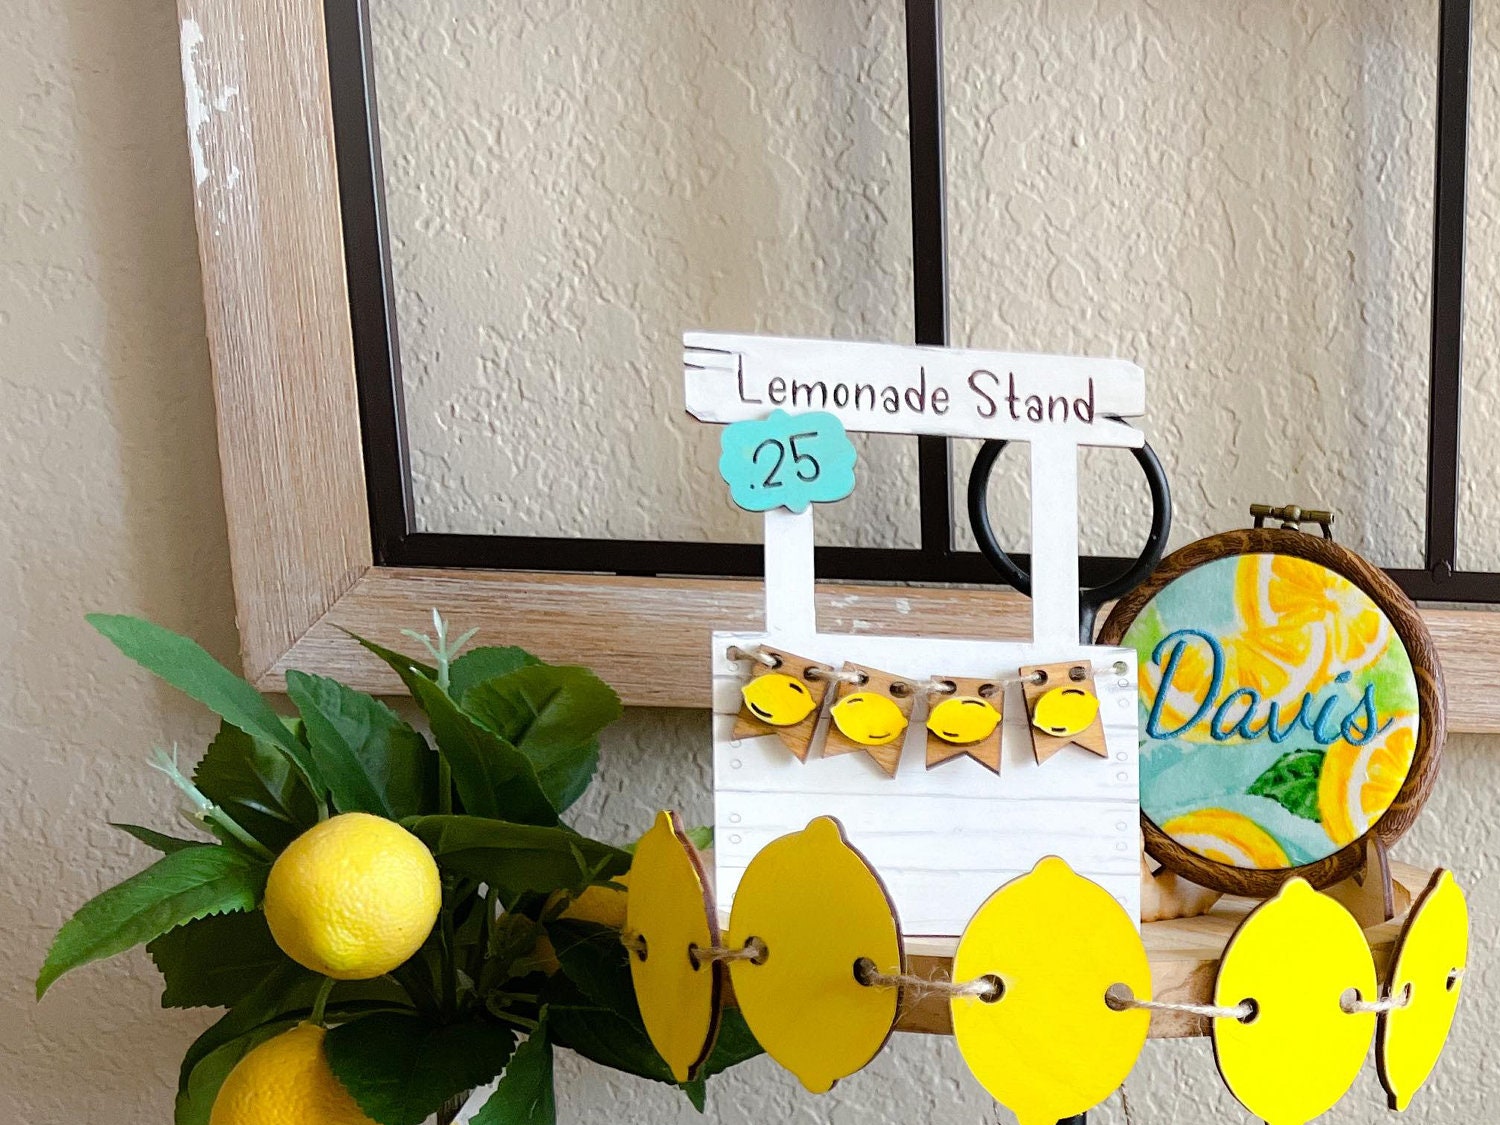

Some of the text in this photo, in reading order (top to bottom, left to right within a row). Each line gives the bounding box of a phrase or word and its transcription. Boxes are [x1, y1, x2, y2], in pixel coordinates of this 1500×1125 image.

[737, 353, 1096, 424] Lemonade Stand
[749, 431, 822, 490] .25
[1146, 629, 1394, 746] Davis
